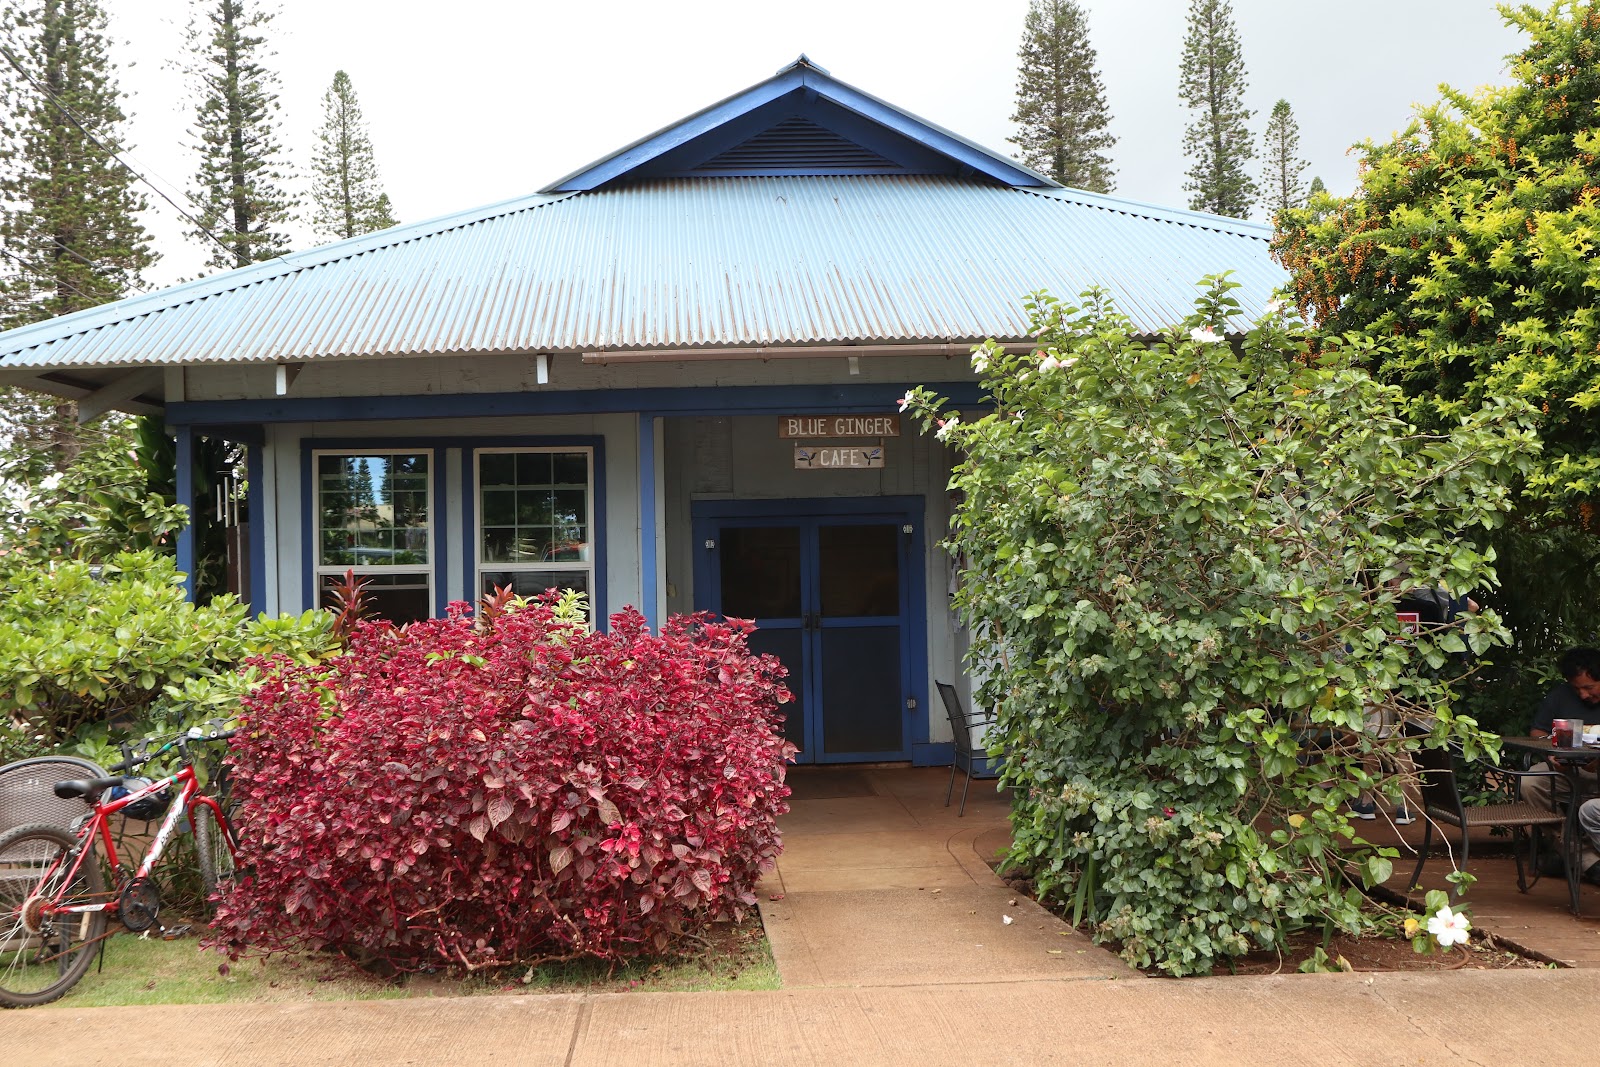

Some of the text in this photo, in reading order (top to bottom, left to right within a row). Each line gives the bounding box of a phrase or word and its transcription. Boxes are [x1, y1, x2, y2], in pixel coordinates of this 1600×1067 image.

[788, 418, 894, 435] BLUE GINGER
[820, 449, 859, 466] CAFE
